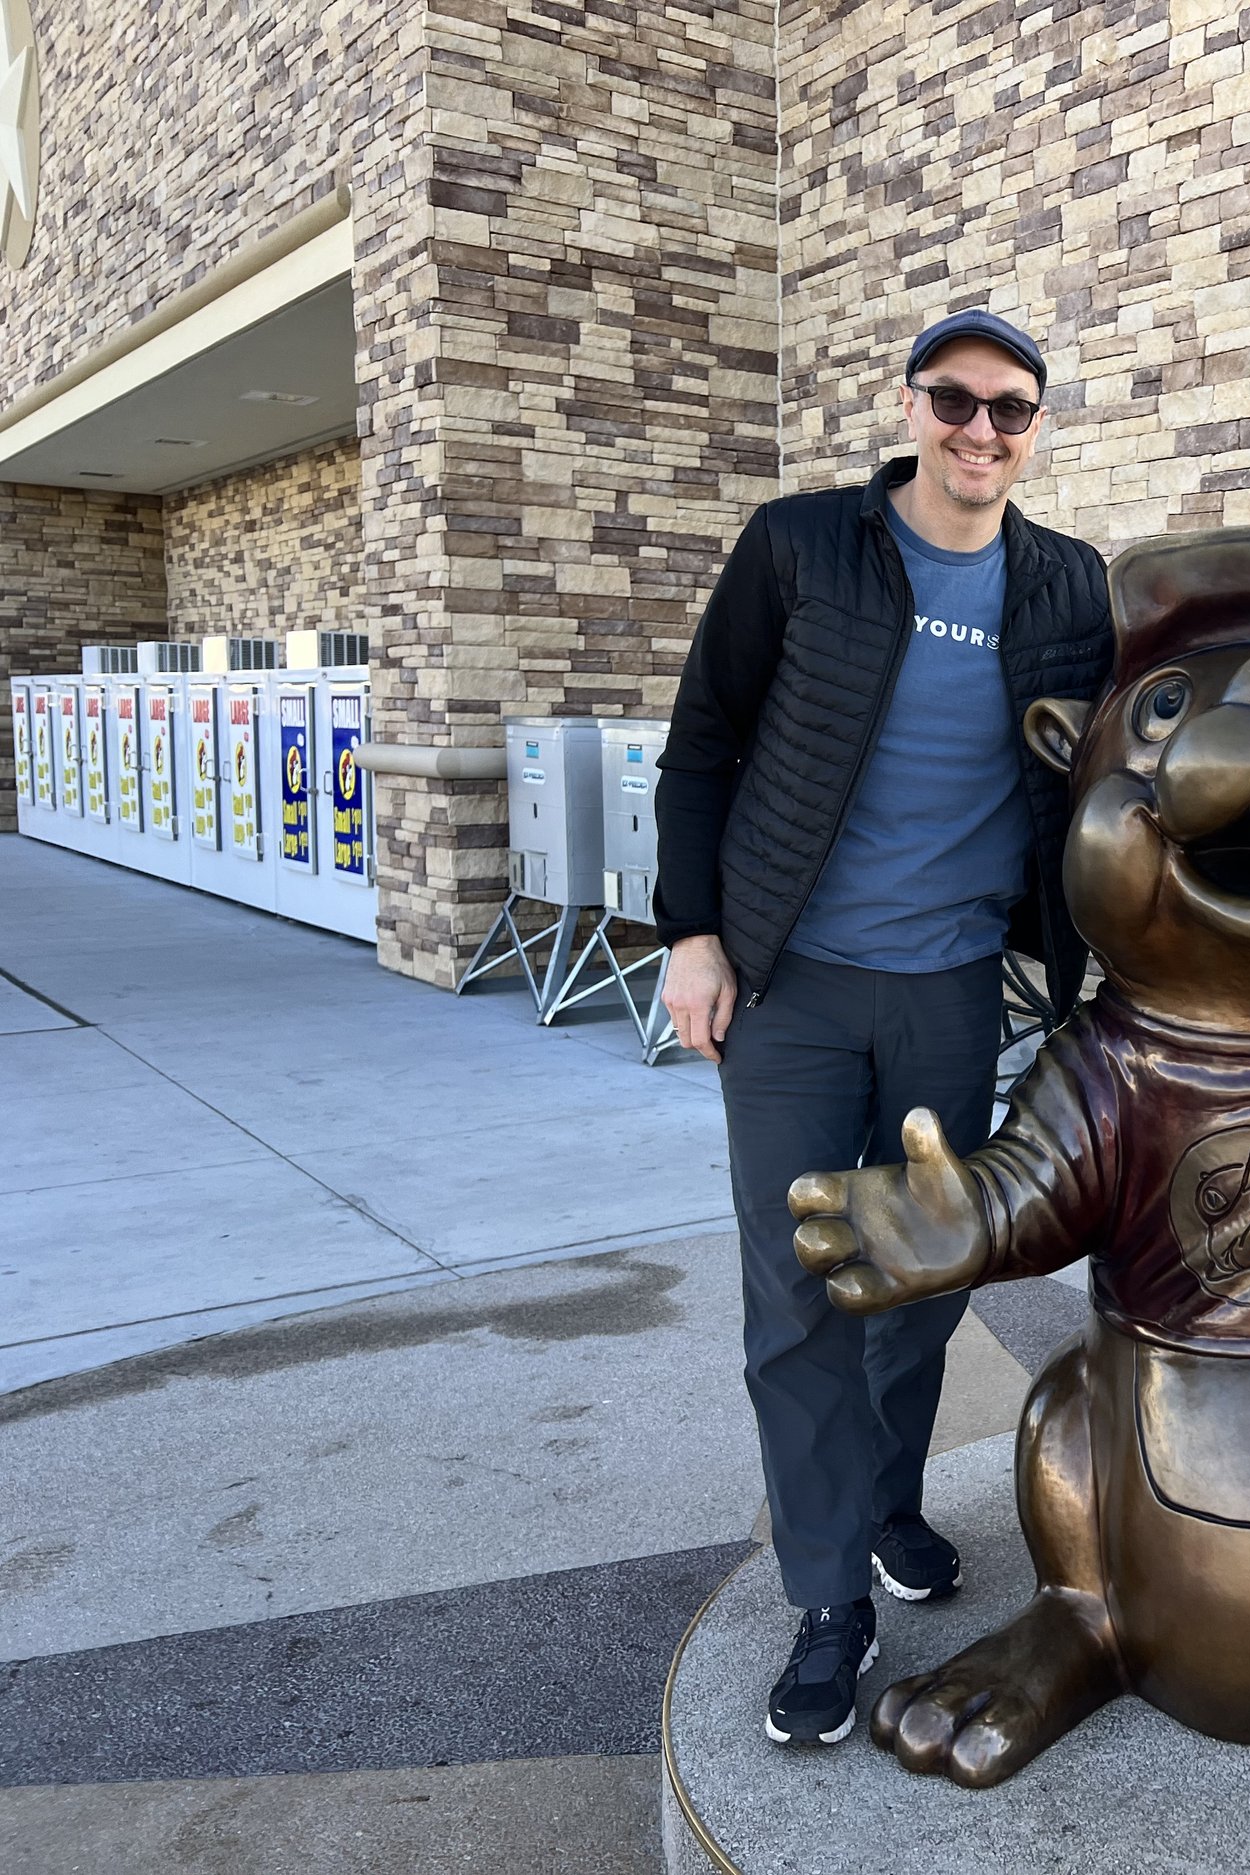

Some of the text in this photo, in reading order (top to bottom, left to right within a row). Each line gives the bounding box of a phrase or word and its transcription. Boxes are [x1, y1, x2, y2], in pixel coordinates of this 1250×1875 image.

[192, 699, 210, 723] LARGE
[230, 700, 249, 725] LARGE
[281, 699, 305, 728] SMALL
[333, 699, 360, 729] SMALL
